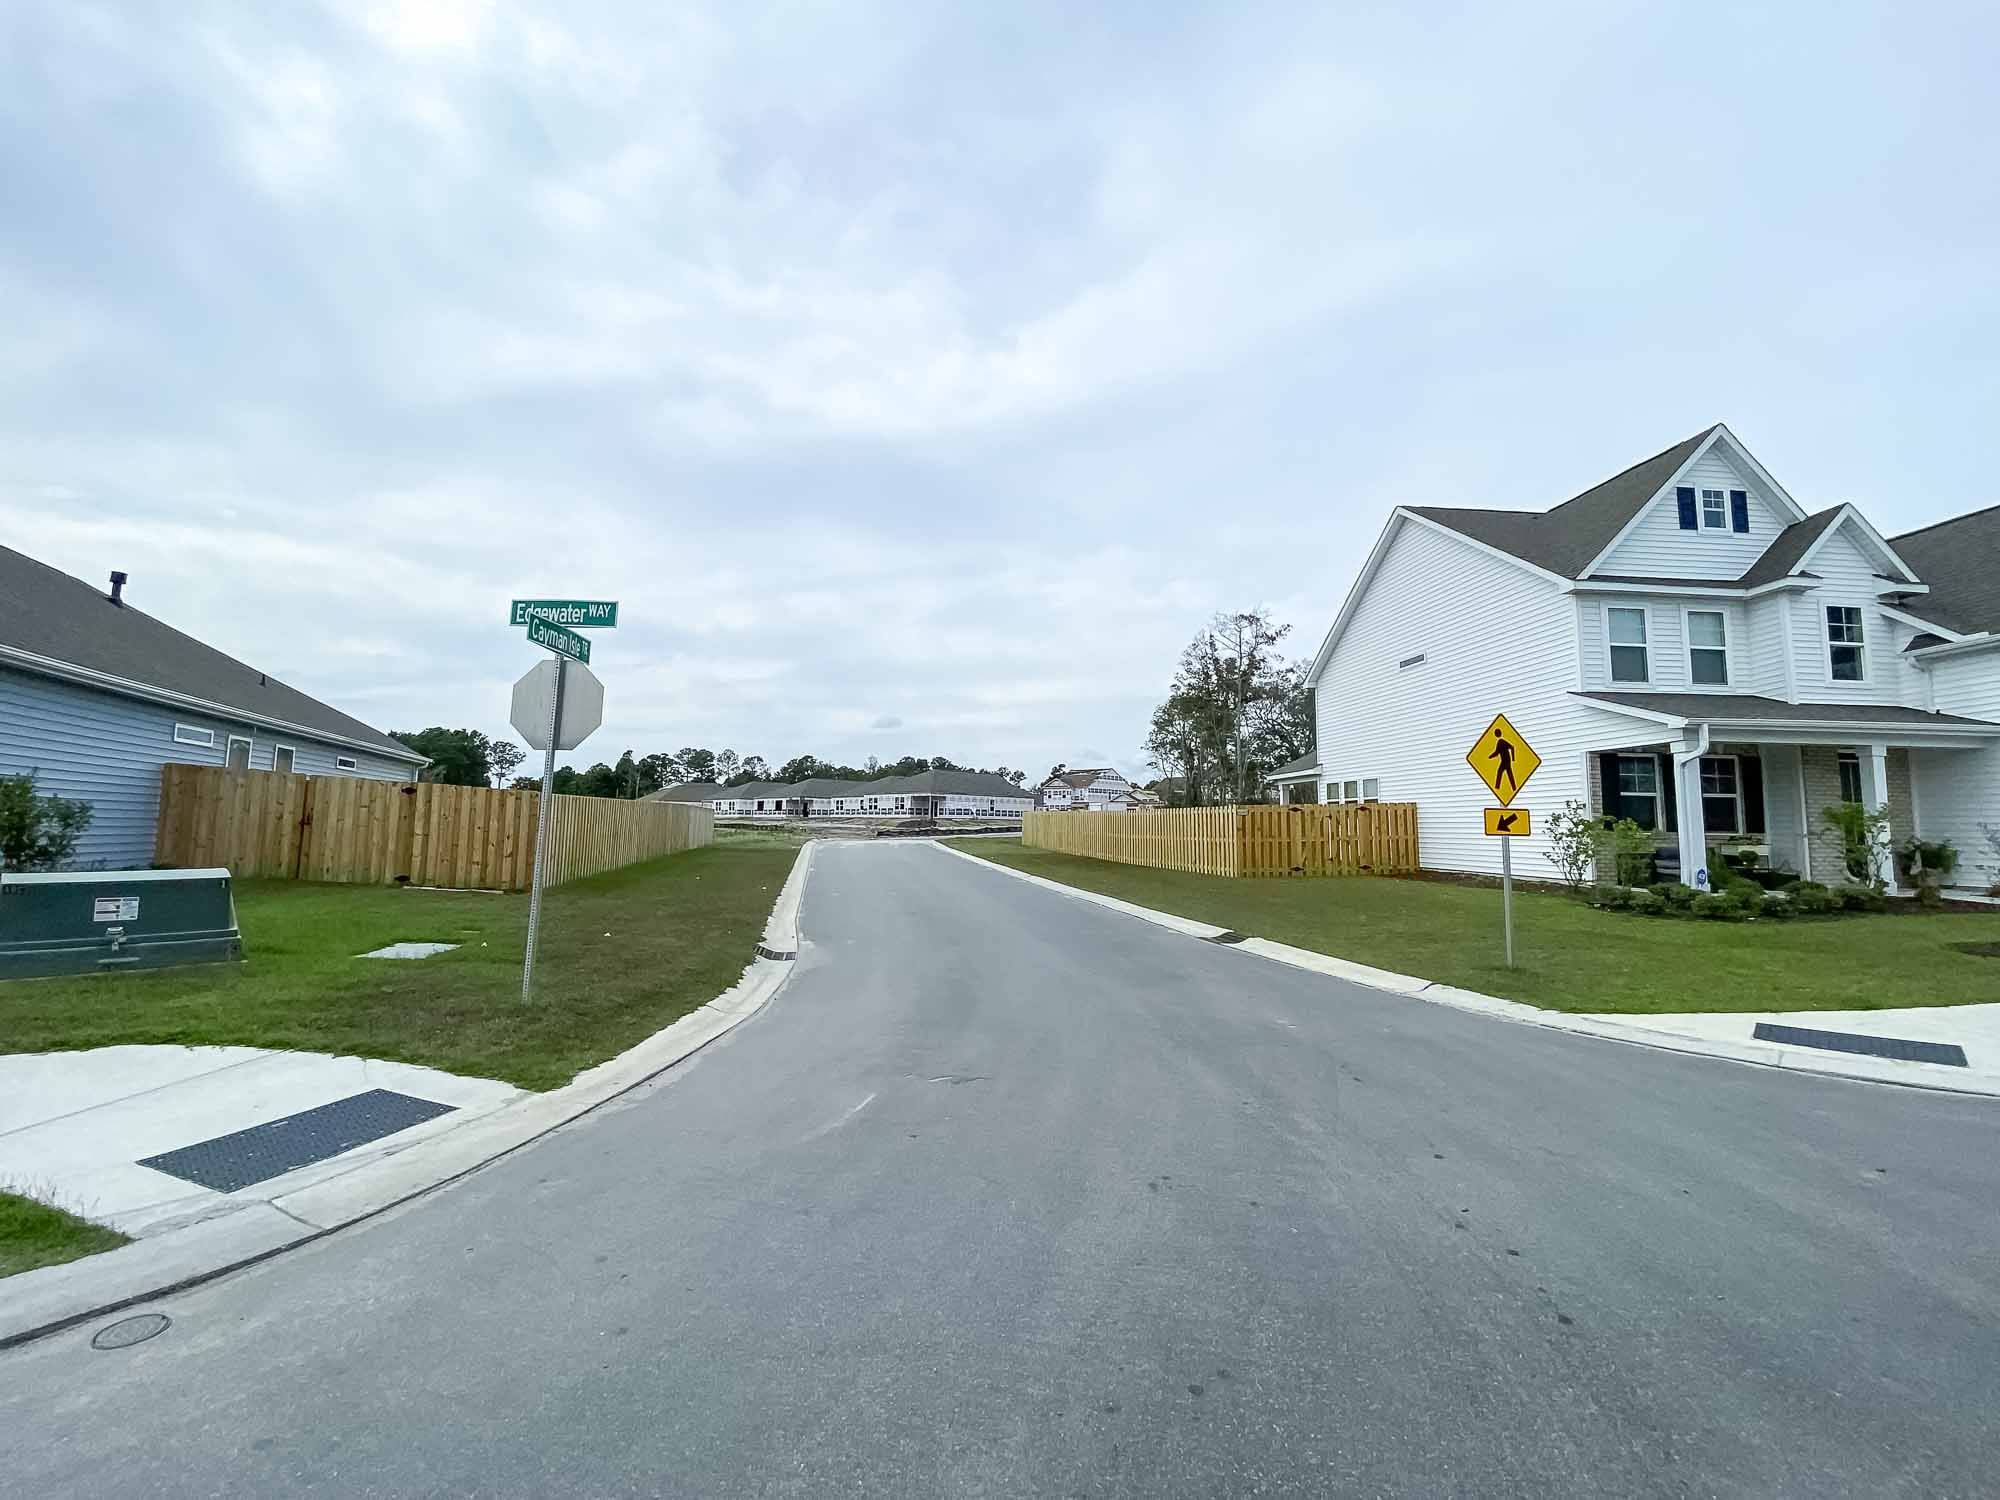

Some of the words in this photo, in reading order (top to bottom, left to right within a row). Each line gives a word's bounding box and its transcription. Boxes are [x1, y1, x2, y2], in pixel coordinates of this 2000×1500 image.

[588, 604, 611, 618] WAY
[532, 618, 568, 649] Cayman
[569, 634, 581, 656] Isle
